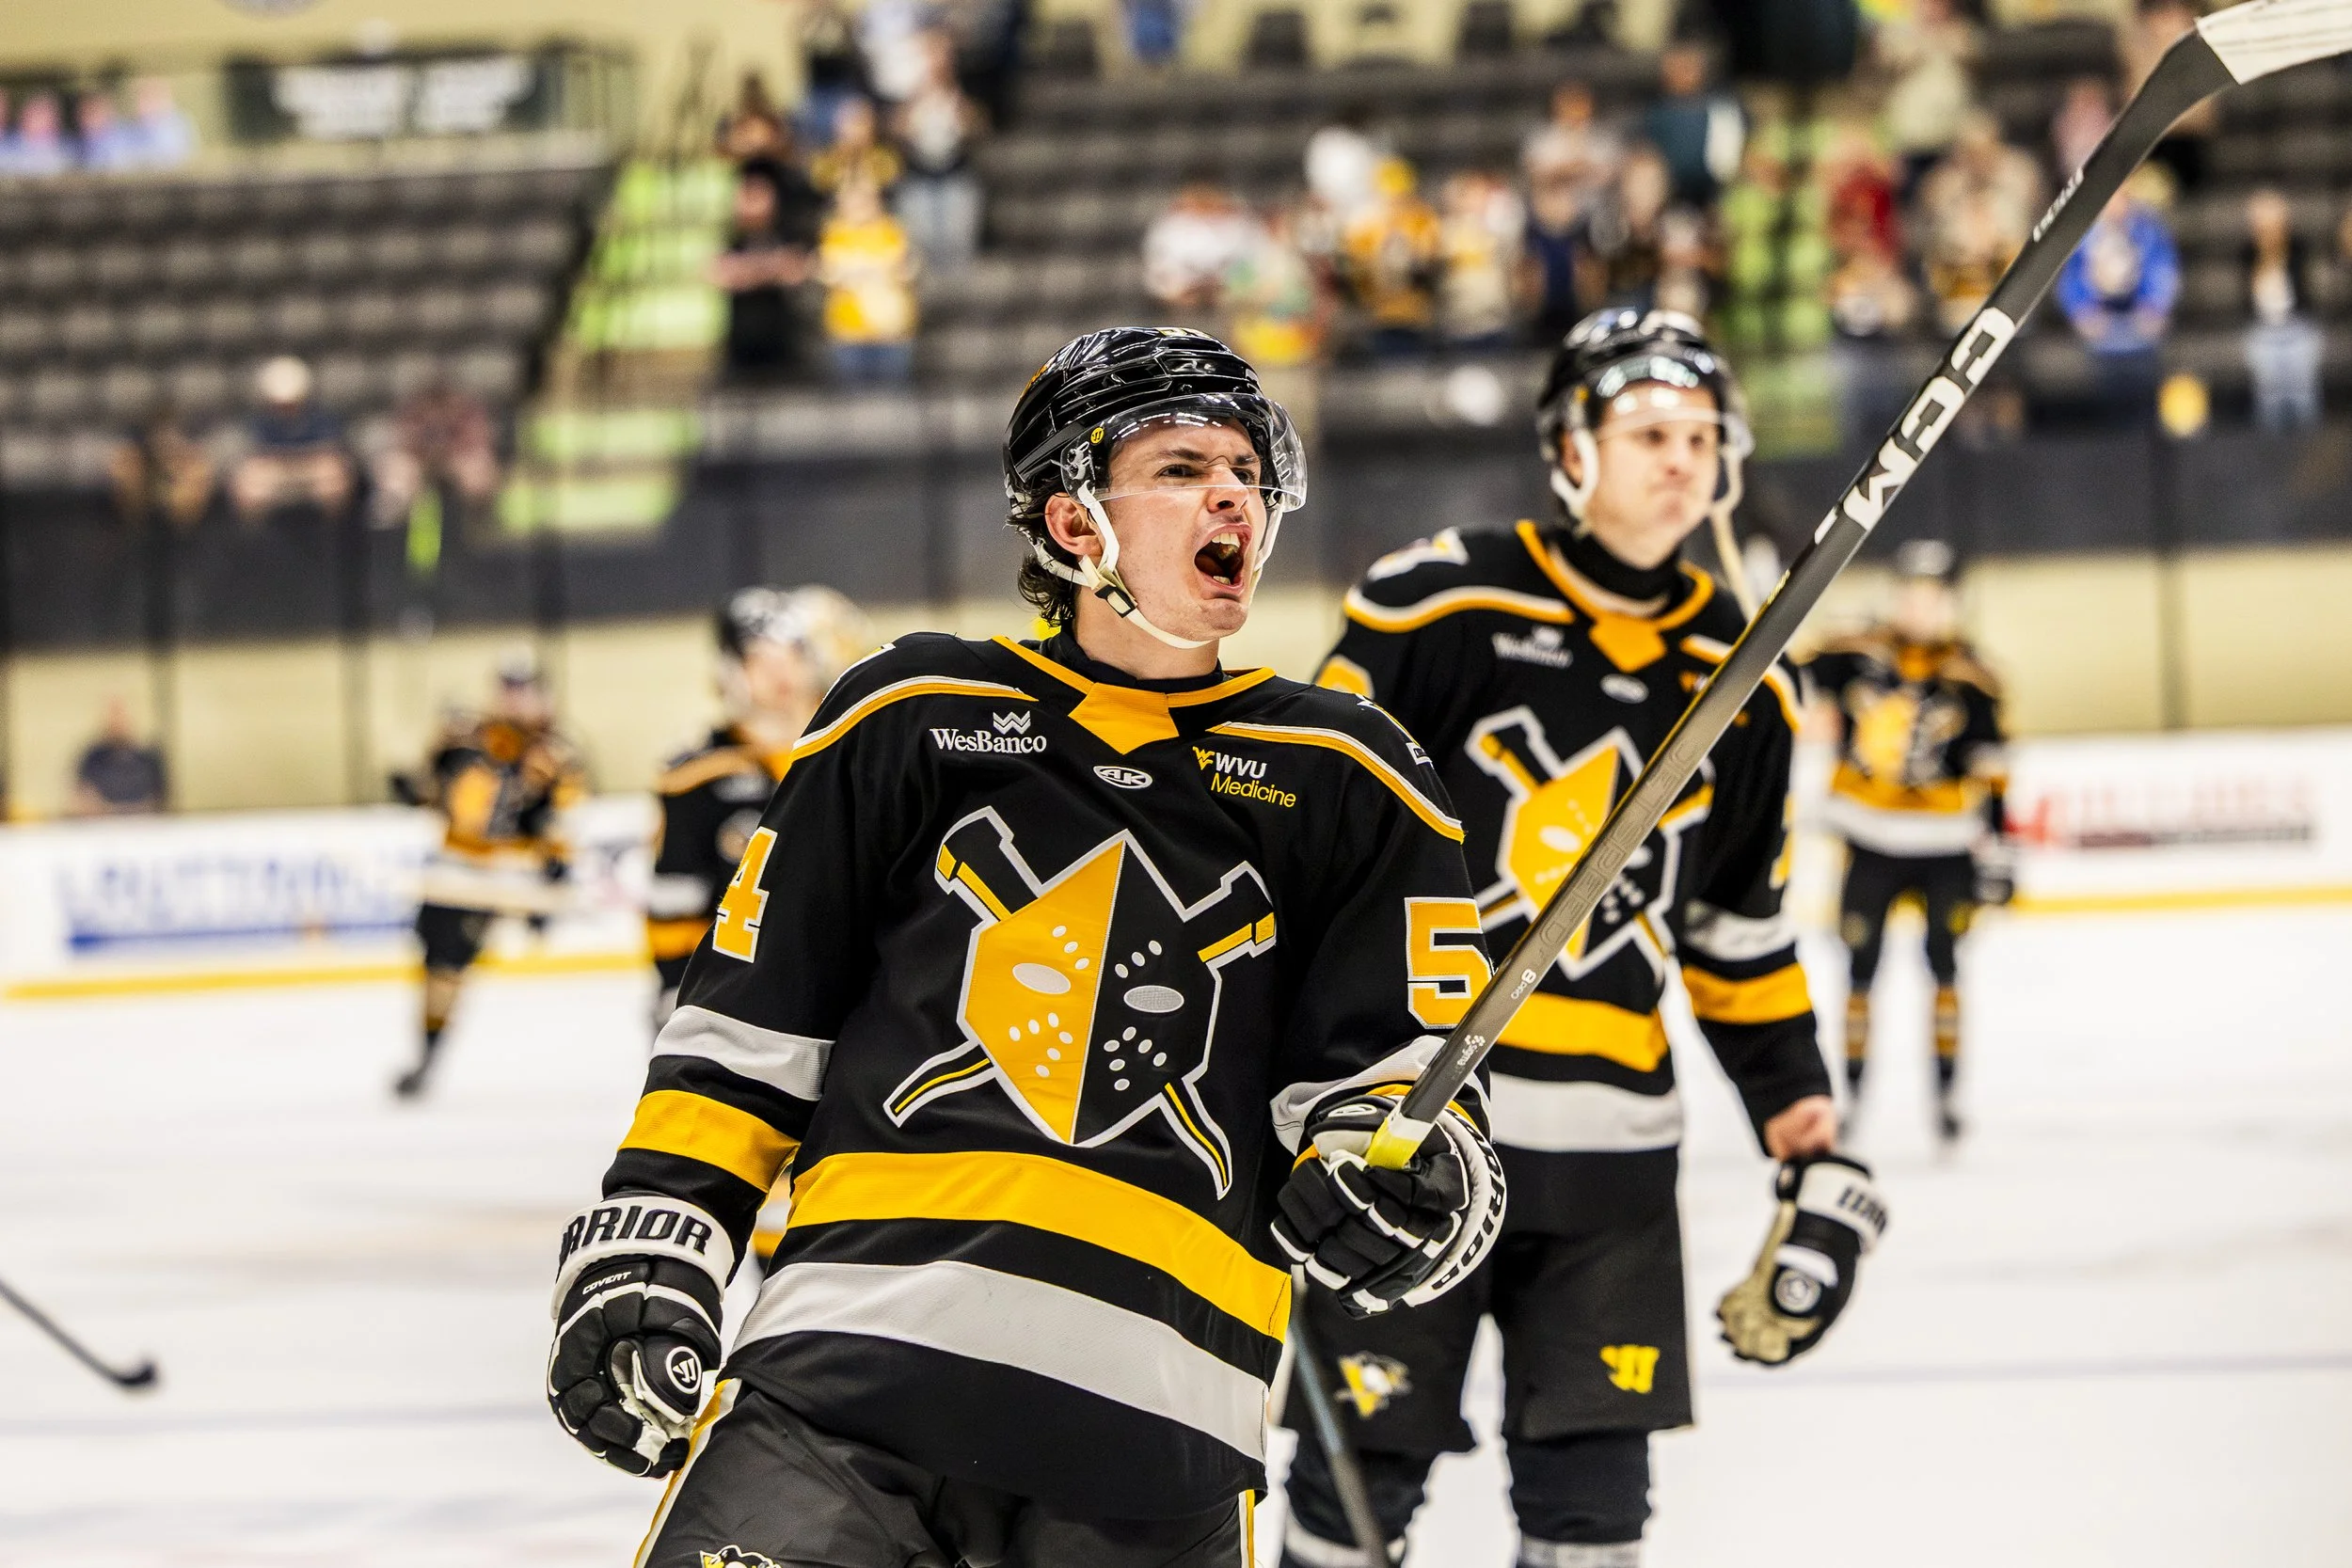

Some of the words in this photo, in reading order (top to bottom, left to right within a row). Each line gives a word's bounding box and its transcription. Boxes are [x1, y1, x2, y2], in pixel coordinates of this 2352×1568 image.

[1843, 307, 2016, 531] CCM
[929, 728, 1047, 753] WesBanco
[1216, 752, 1267, 779] WVU
[1211, 772, 1296, 808] Medicine
[712, 826, 778, 963] 4
[1405, 896, 1492, 1029] 5
[582, 1271, 631, 1295] COVERT
